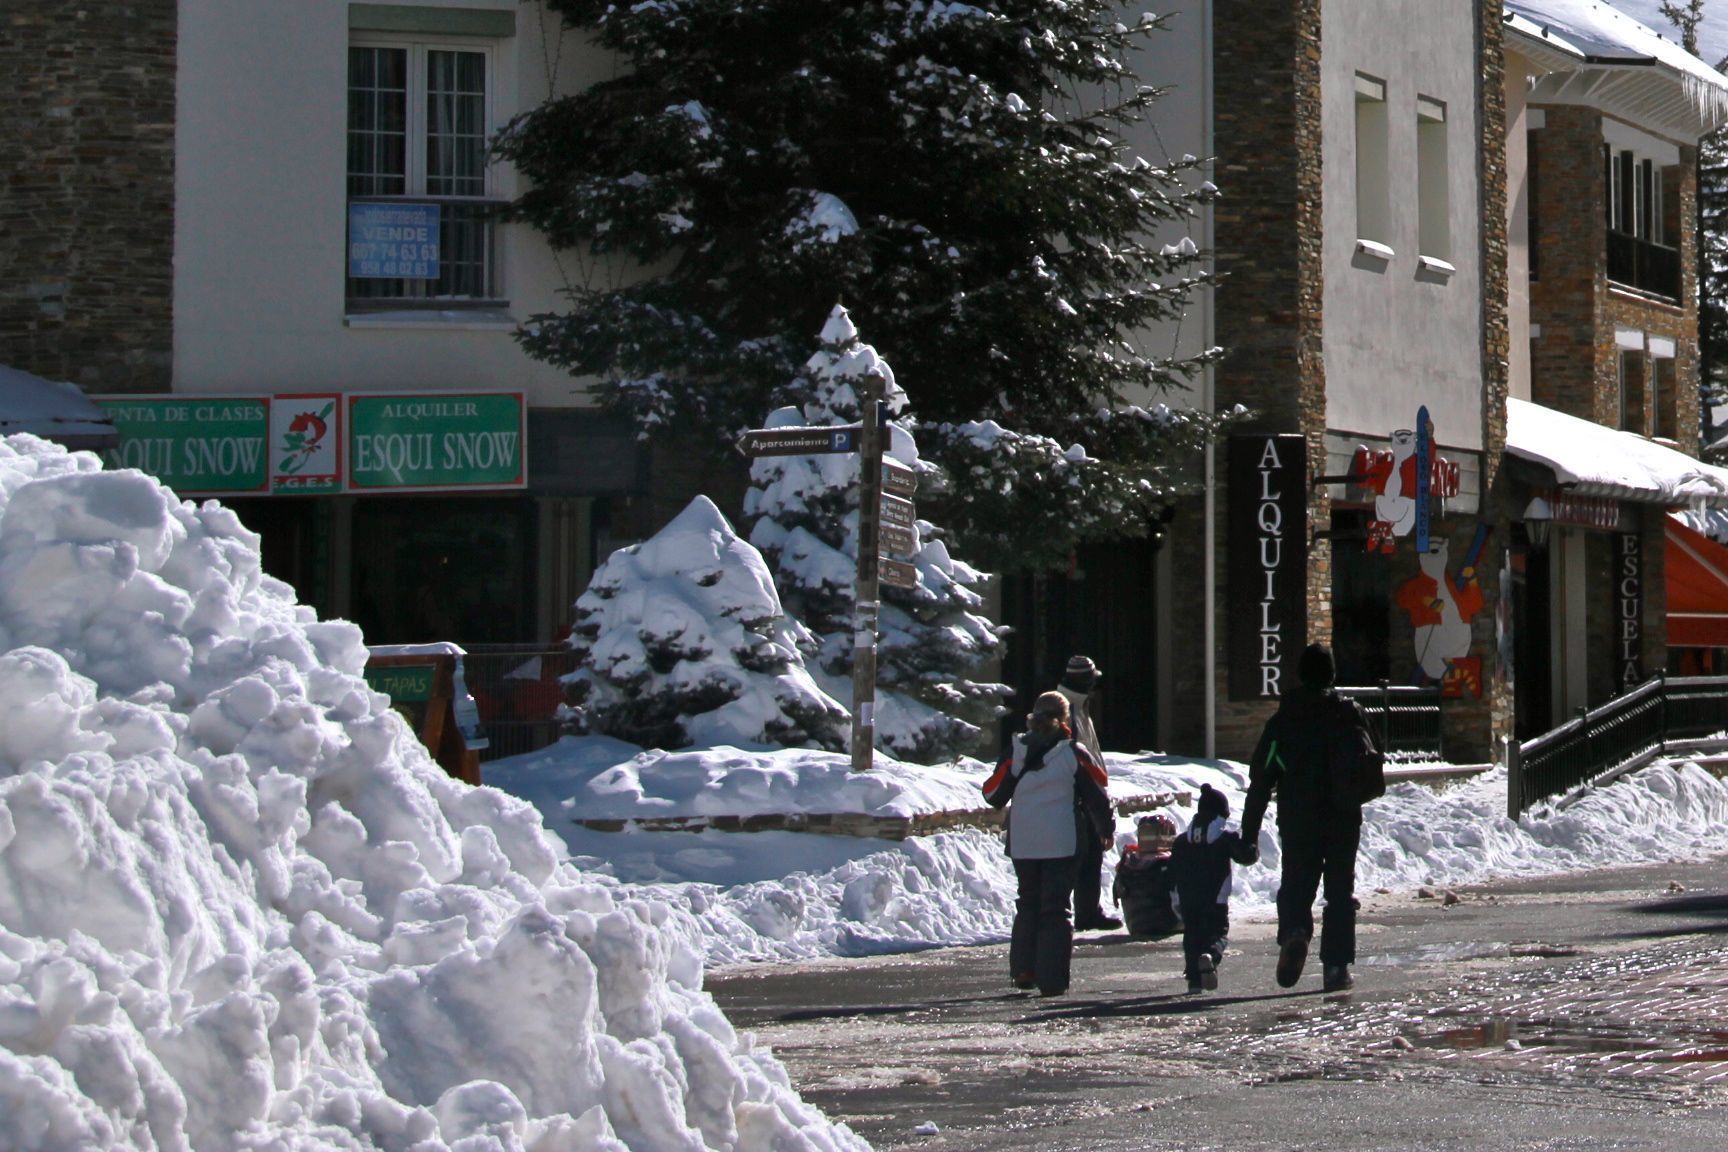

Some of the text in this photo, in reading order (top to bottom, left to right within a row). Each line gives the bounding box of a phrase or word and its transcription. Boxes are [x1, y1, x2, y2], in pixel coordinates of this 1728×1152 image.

[362, 227, 428, 242] VENDE
[104, 405, 265, 422] ENTA DE CLASES
[382, 402, 479, 420] ALQUILER
[751, 433, 847, 451] Aparcamiento P
[183, 435, 264, 477] SNOW
[355, 431, 518, 483] ESQUI SNOW
[1257, 438, 1283, 696] ALQUILER
[1621, 535, 1639, 682] ESCUELA
[384, 675, 426, 695] TAPAS
